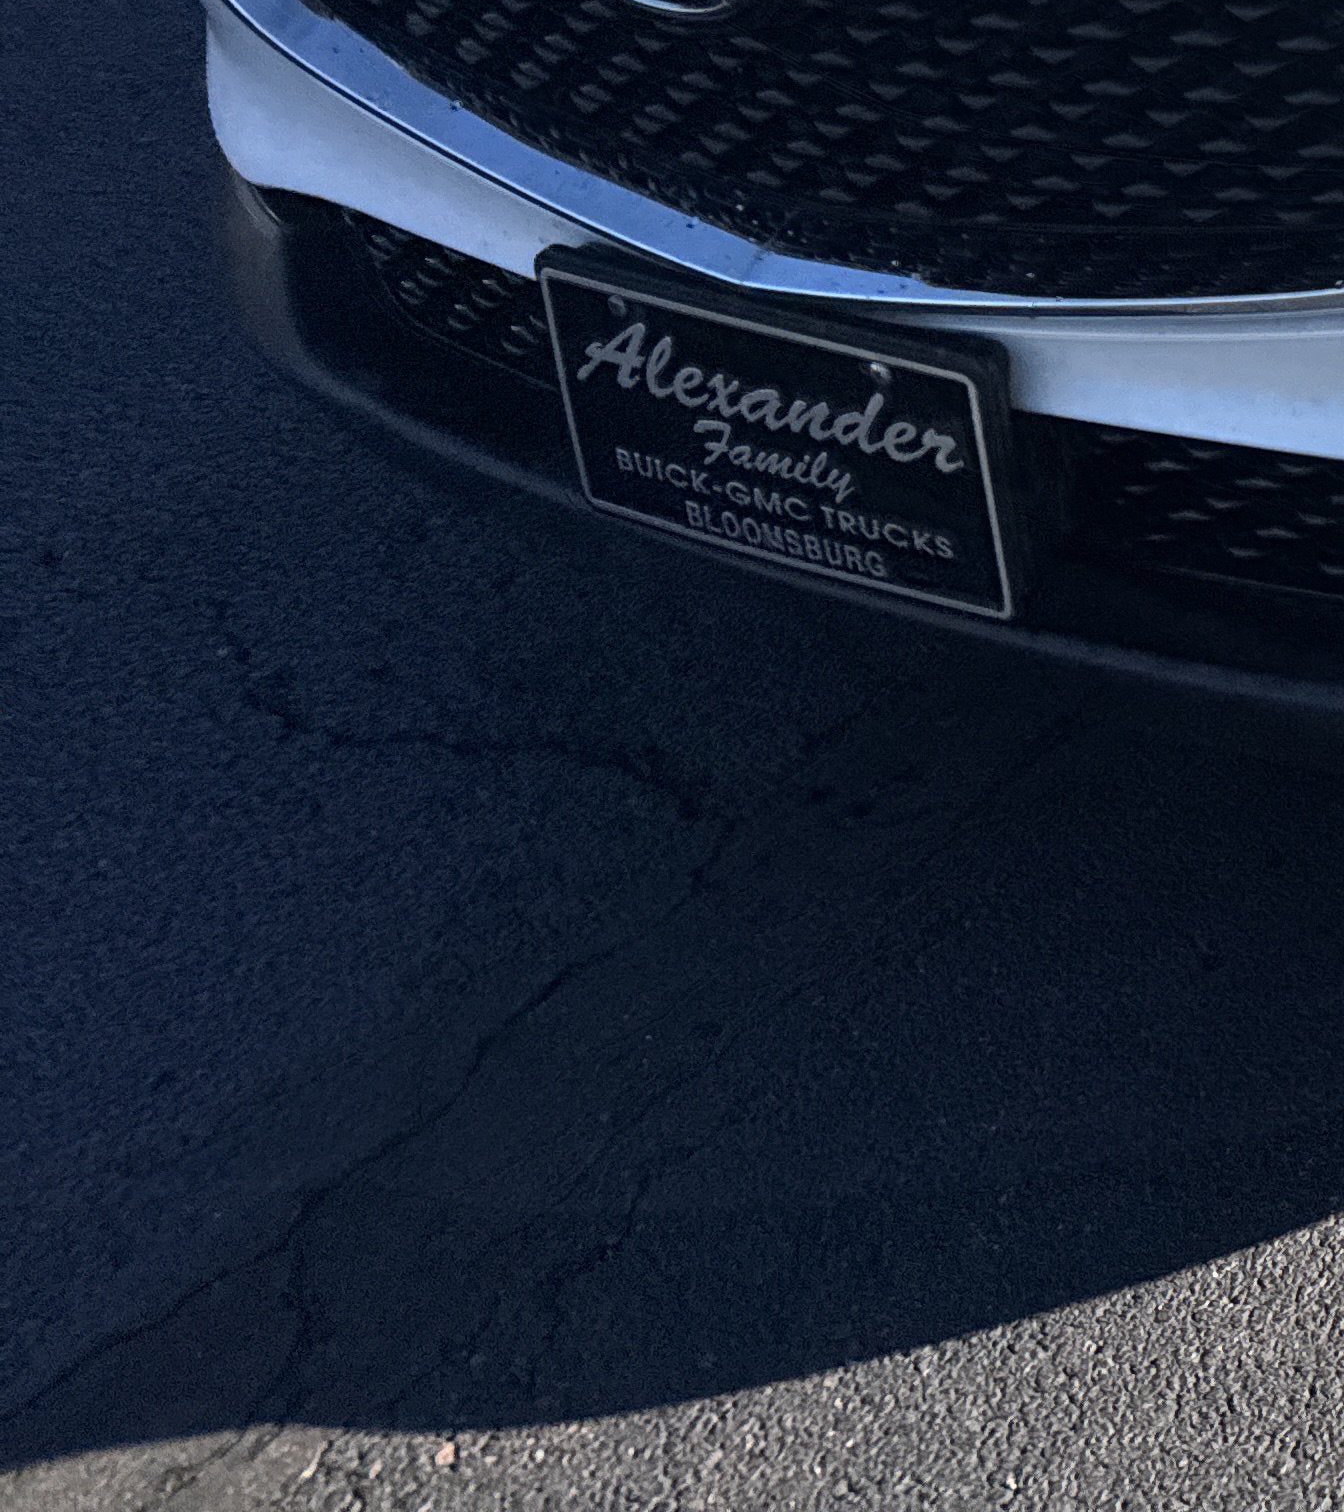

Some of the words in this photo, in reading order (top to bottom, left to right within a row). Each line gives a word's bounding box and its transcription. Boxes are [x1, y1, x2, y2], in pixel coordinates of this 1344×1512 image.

[576, 322, 964, 474] Alexander
[615, 447, 812, 522] BUICK-GMC
[820, 504, 954, 560] TRUCKS
[693, 419, 855, 503] Family
[685, 500, 888, 577] BLOOMSBURG
